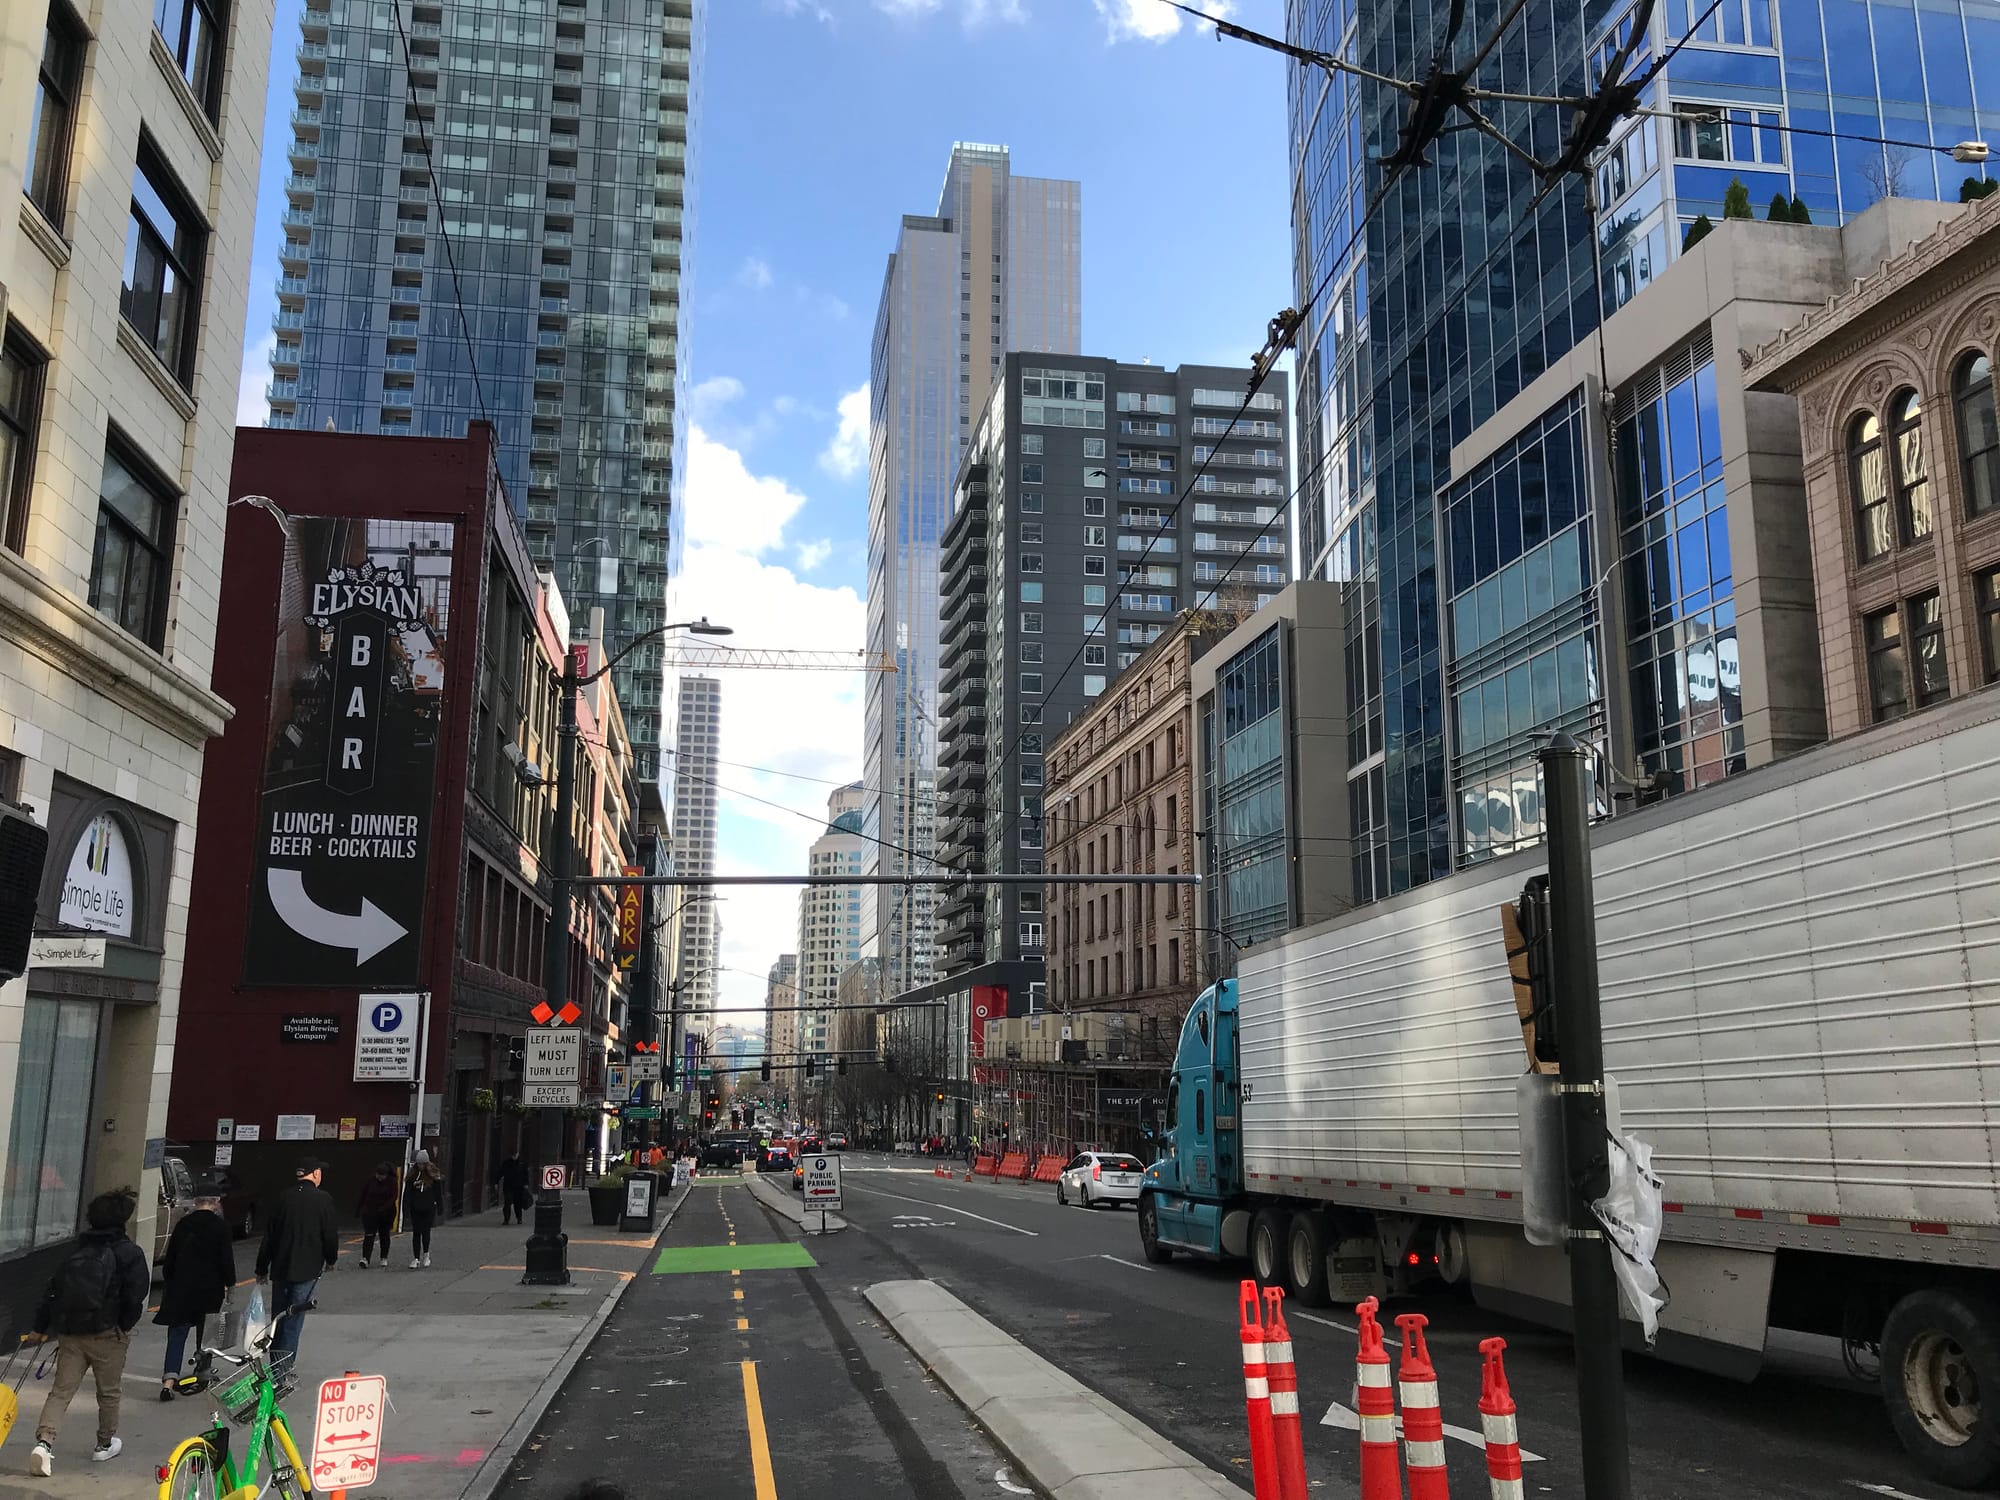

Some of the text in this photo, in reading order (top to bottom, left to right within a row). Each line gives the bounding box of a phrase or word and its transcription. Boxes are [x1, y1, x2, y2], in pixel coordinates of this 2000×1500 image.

[313, 584, 419, 620] ELYSIAN
[342, 635, 371, 770] BAR
[272, 812, 418, 837] LUNCH DINNER
[270, 836, 417, 859] BEER COCKTAILS
[60, 876, 124, 918] Simple Life
[47, 944, 87, 961] Simple Life
[290, 1017, 322, 1025] Available
[284, 1025, 339, 1033] Elysian Brewing
[294, 1032, 328, 1041] Company
[531, 1035, 577, 1044] LEFT LANE
[538, 1050, 567, 1061] MUST
[529, 1067, 576, 1076] TURN LEFT
[537, 1087, 567, 1095] EXCEPT
[532, 1096, 570, 1104] BICYCLES
[1106, 1097, 1122, 1105] THE
[324, 1385, 342, 1400] NO
[326, 1403, 375, 1424] STOPS
